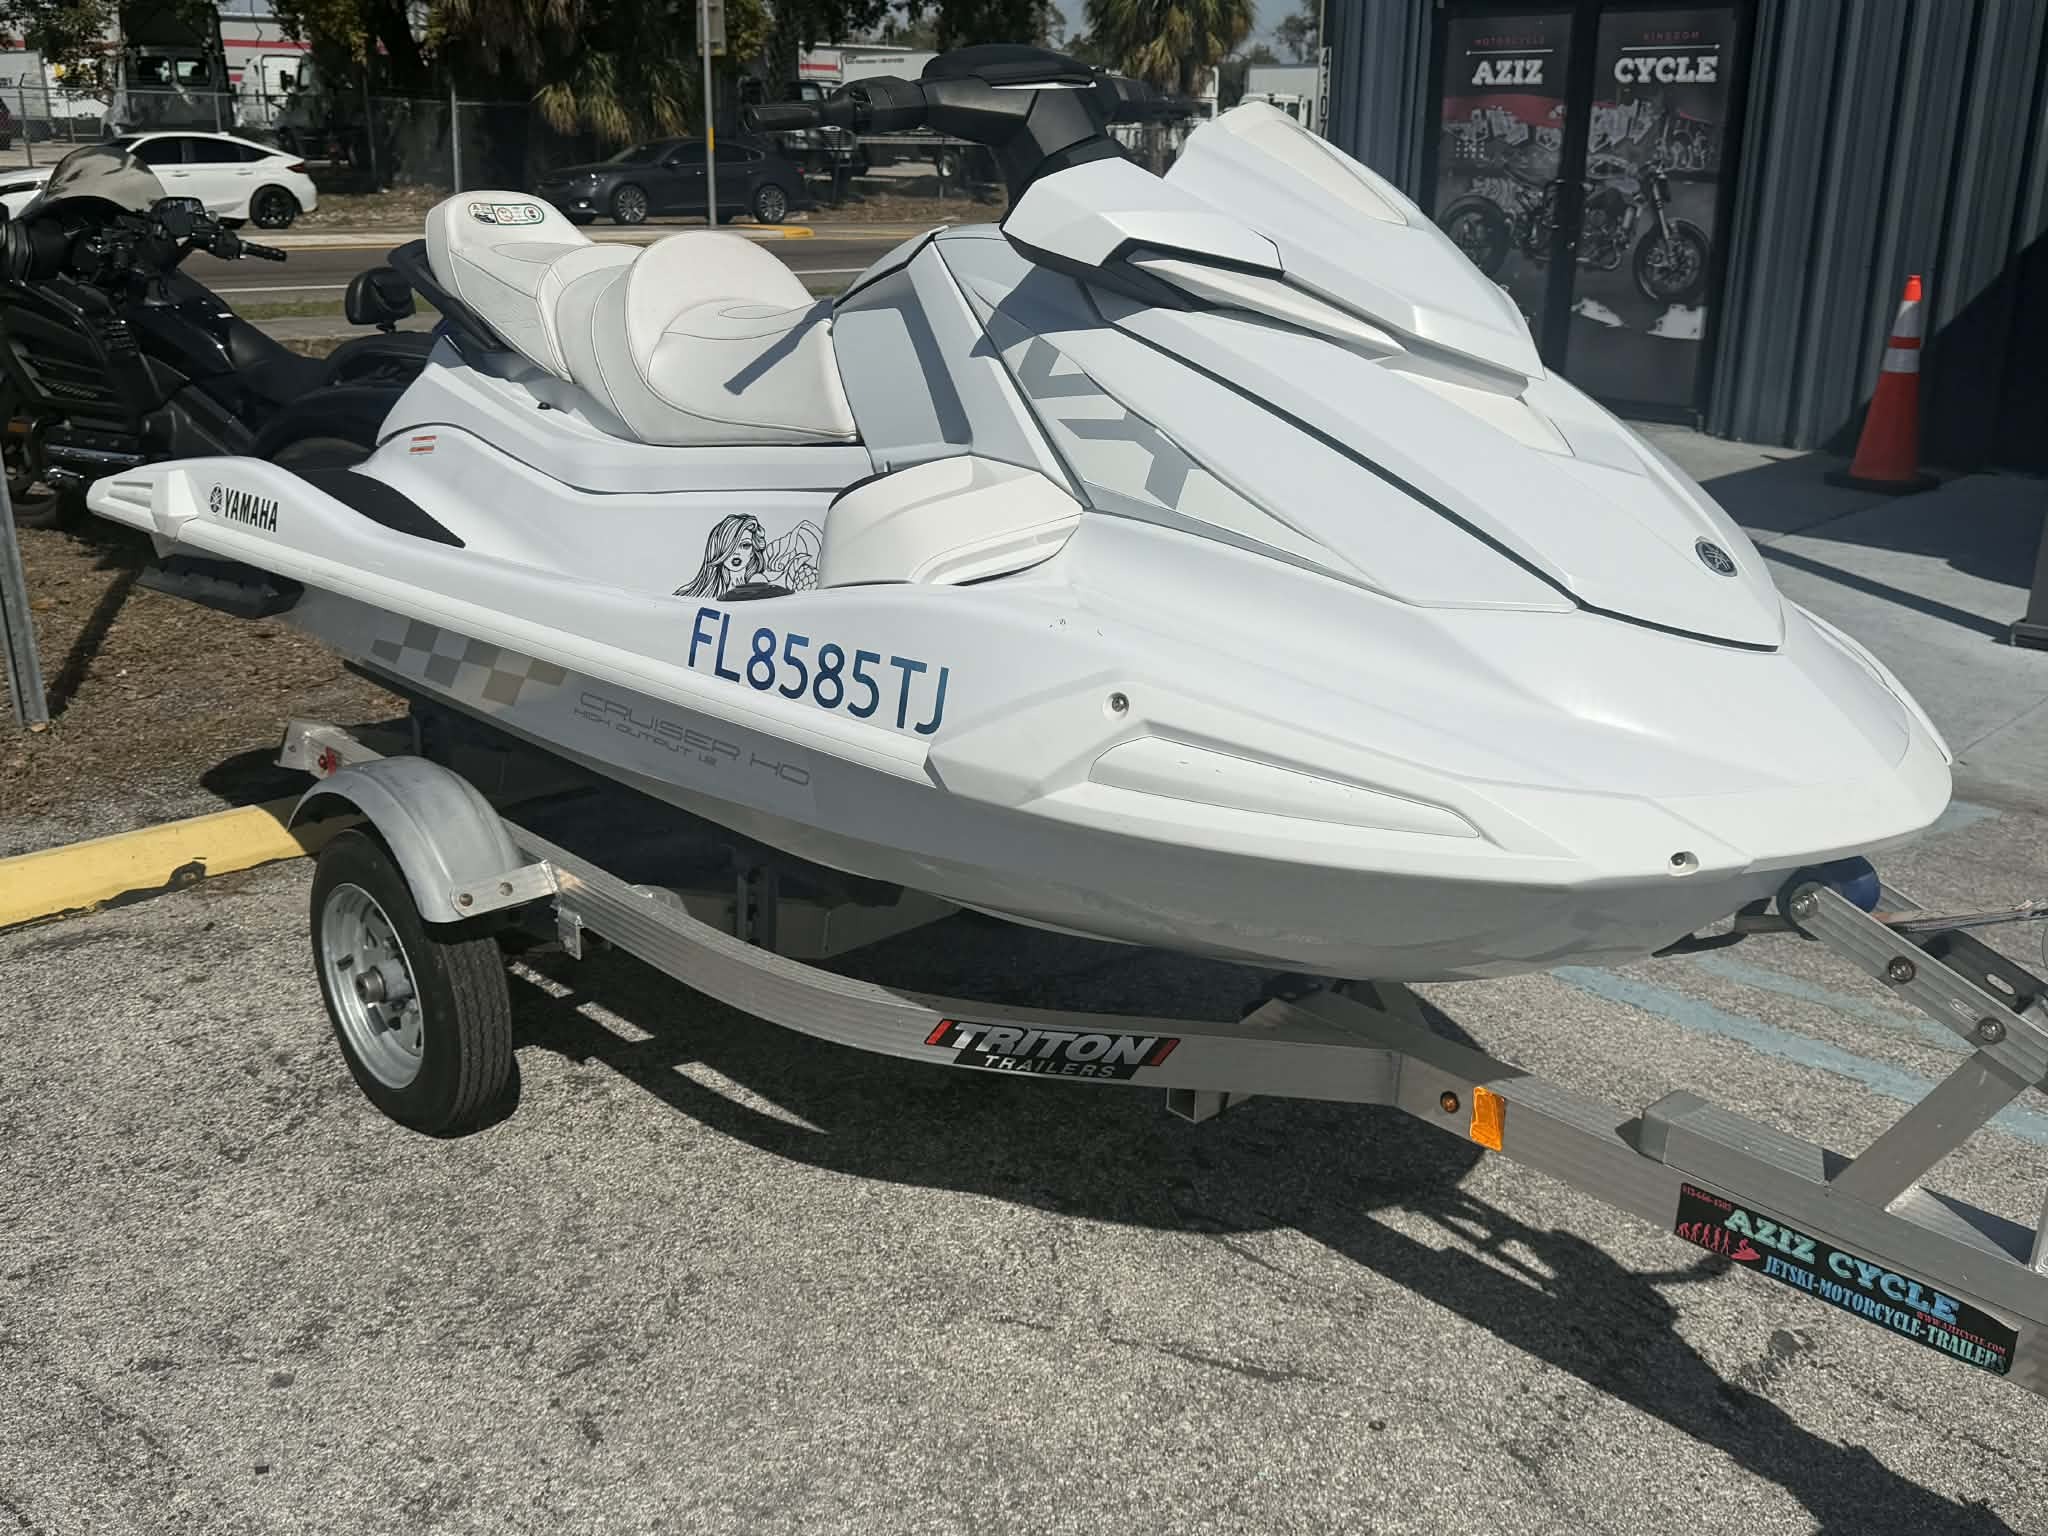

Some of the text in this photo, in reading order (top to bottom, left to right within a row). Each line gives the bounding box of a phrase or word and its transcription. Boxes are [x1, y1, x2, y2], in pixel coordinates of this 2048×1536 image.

[1471, 56, 1719, 86] AZIZ CYCLE
[224, 487, 279, 532] YAMAHA
[573, 708, 612, 728] HIGH
[615, 725, 693, 758] OUTPUT
[579, 691, 811, 787] CRUISER HO
[952, 1022, 1158, 1065] TRITON
[983, 1055, 1117, 1078] TRAILERS
[1724, 1209, 1960, 1325] AZIZ CYCLE
